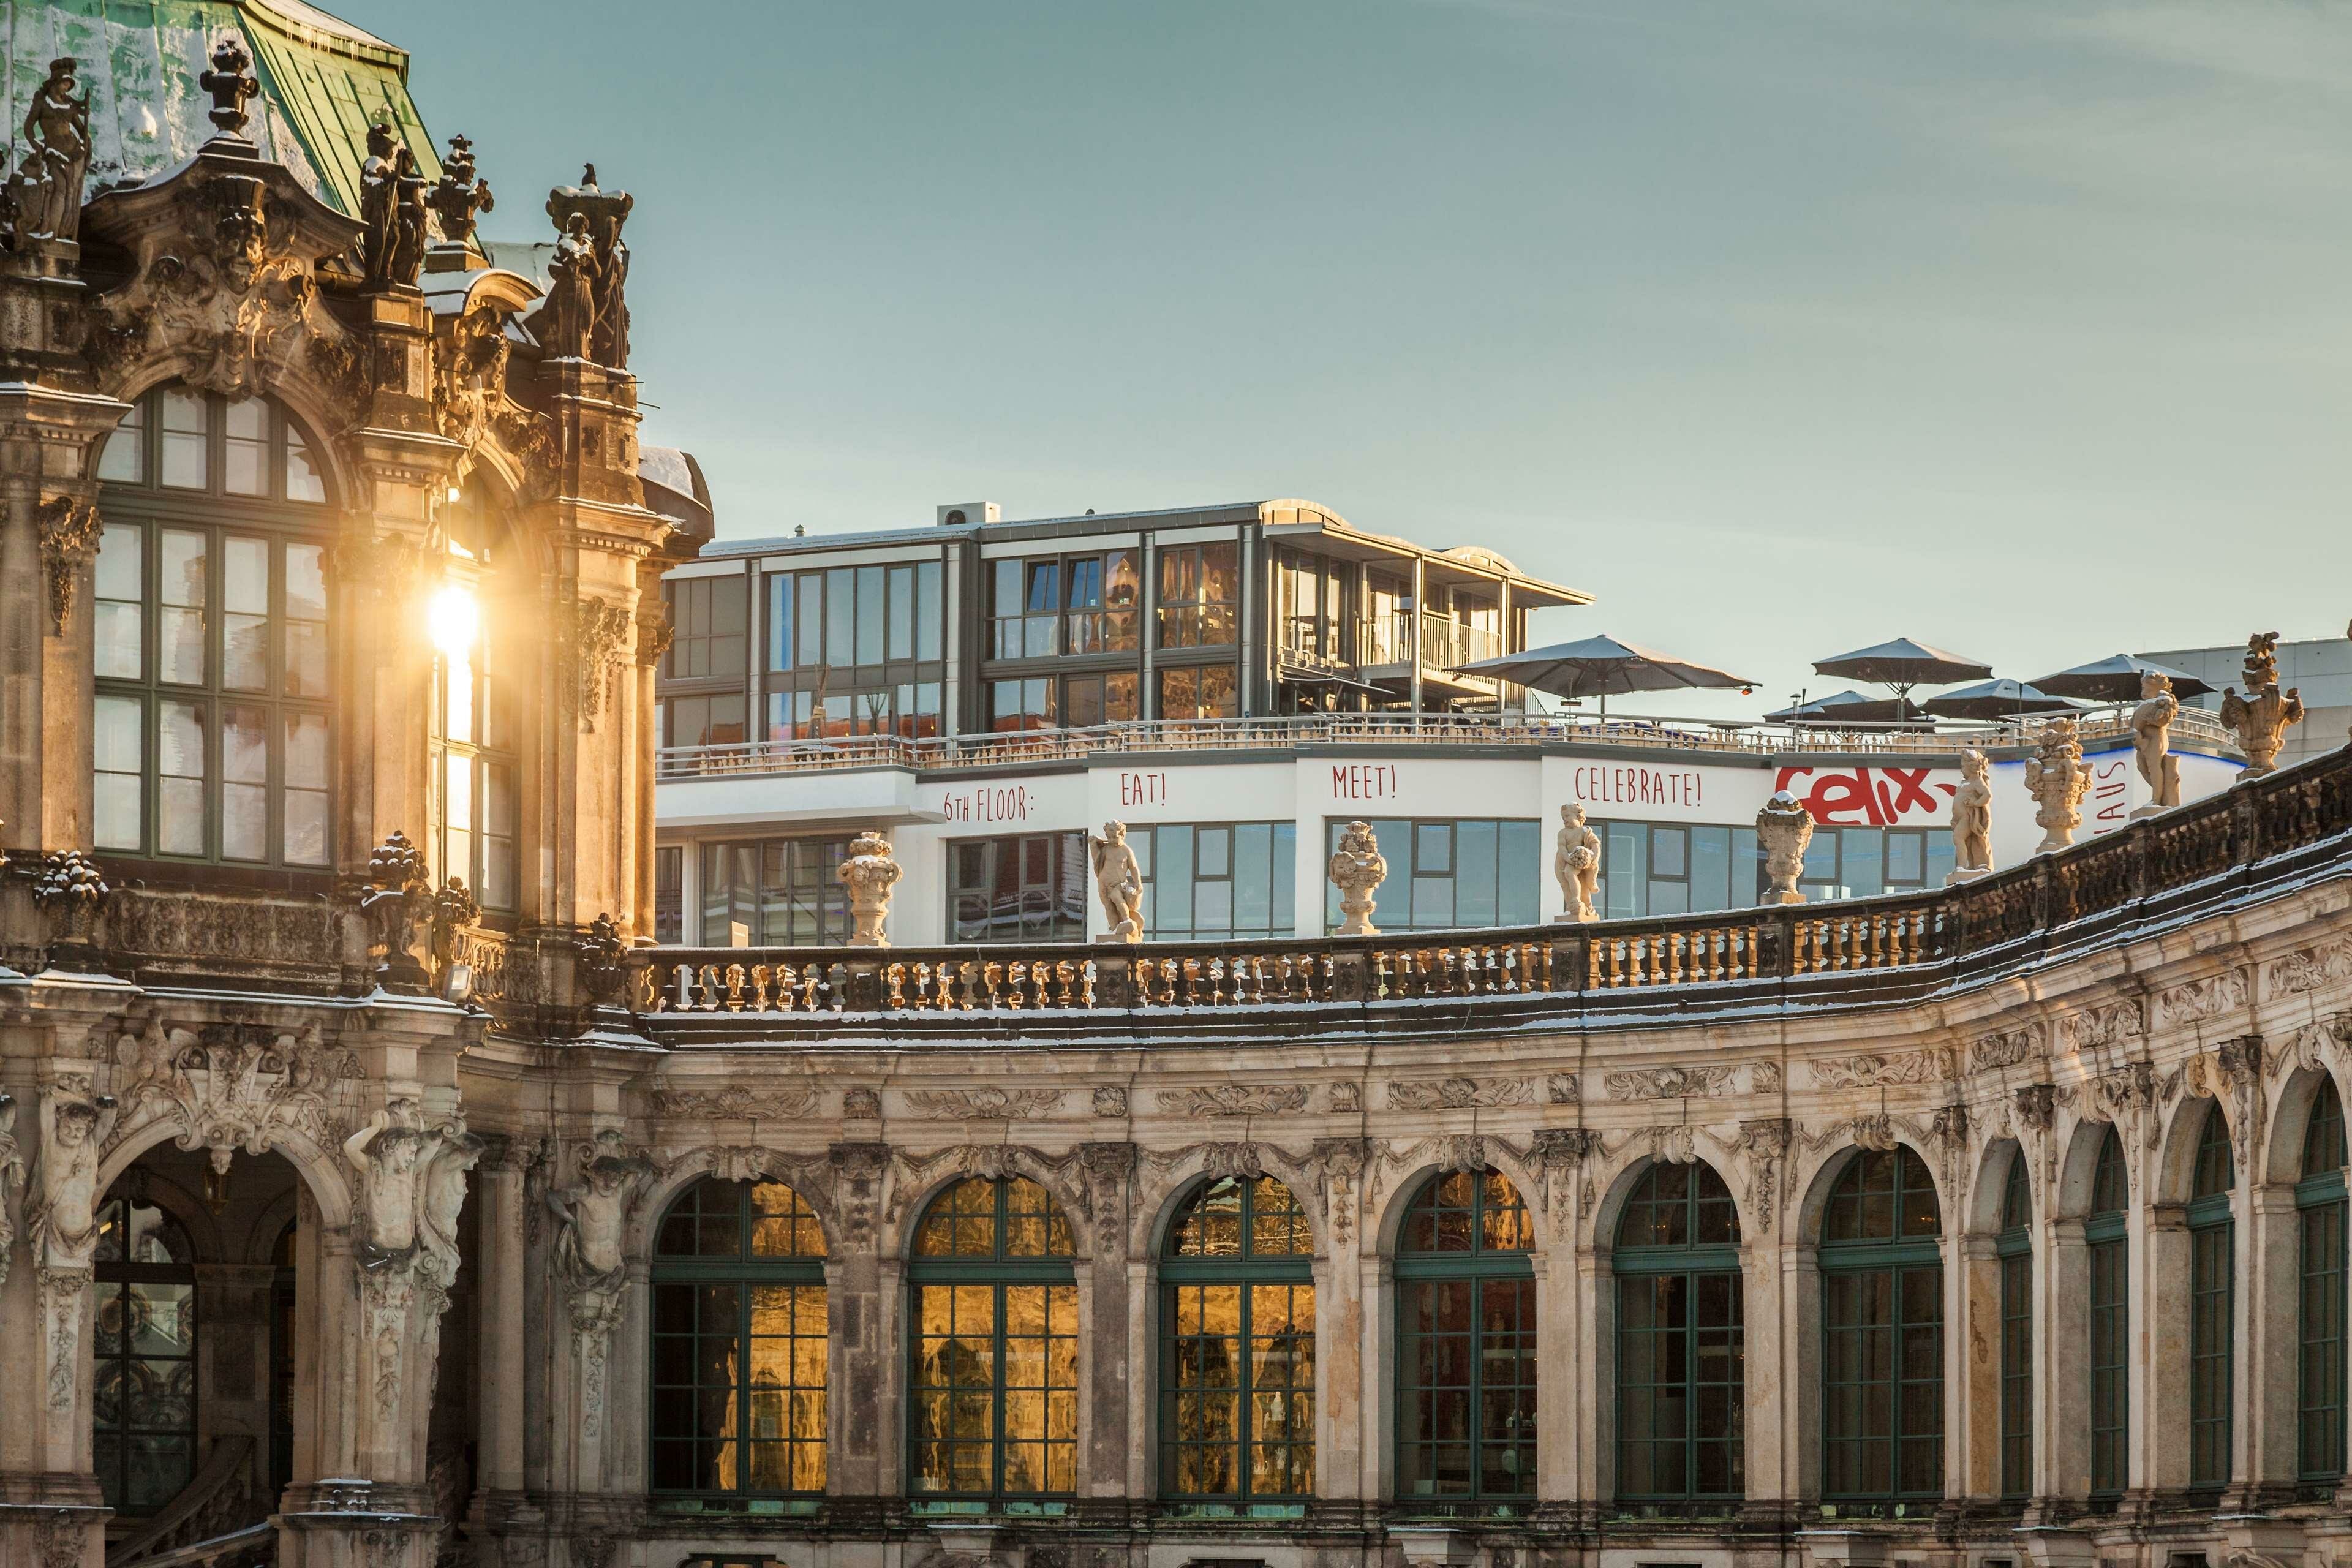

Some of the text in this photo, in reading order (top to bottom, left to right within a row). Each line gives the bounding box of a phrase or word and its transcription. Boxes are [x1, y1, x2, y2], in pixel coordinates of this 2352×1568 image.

[1121, 773, 1166, 806] EAT!
[1333, 765, 1396, 799] MEET!
[1575, 767, 1702, 807] CELEBRATE!
[2094, 761, 2126, 834] AUS
[944, 786, 1034, 822] 6TH FLOOR:
